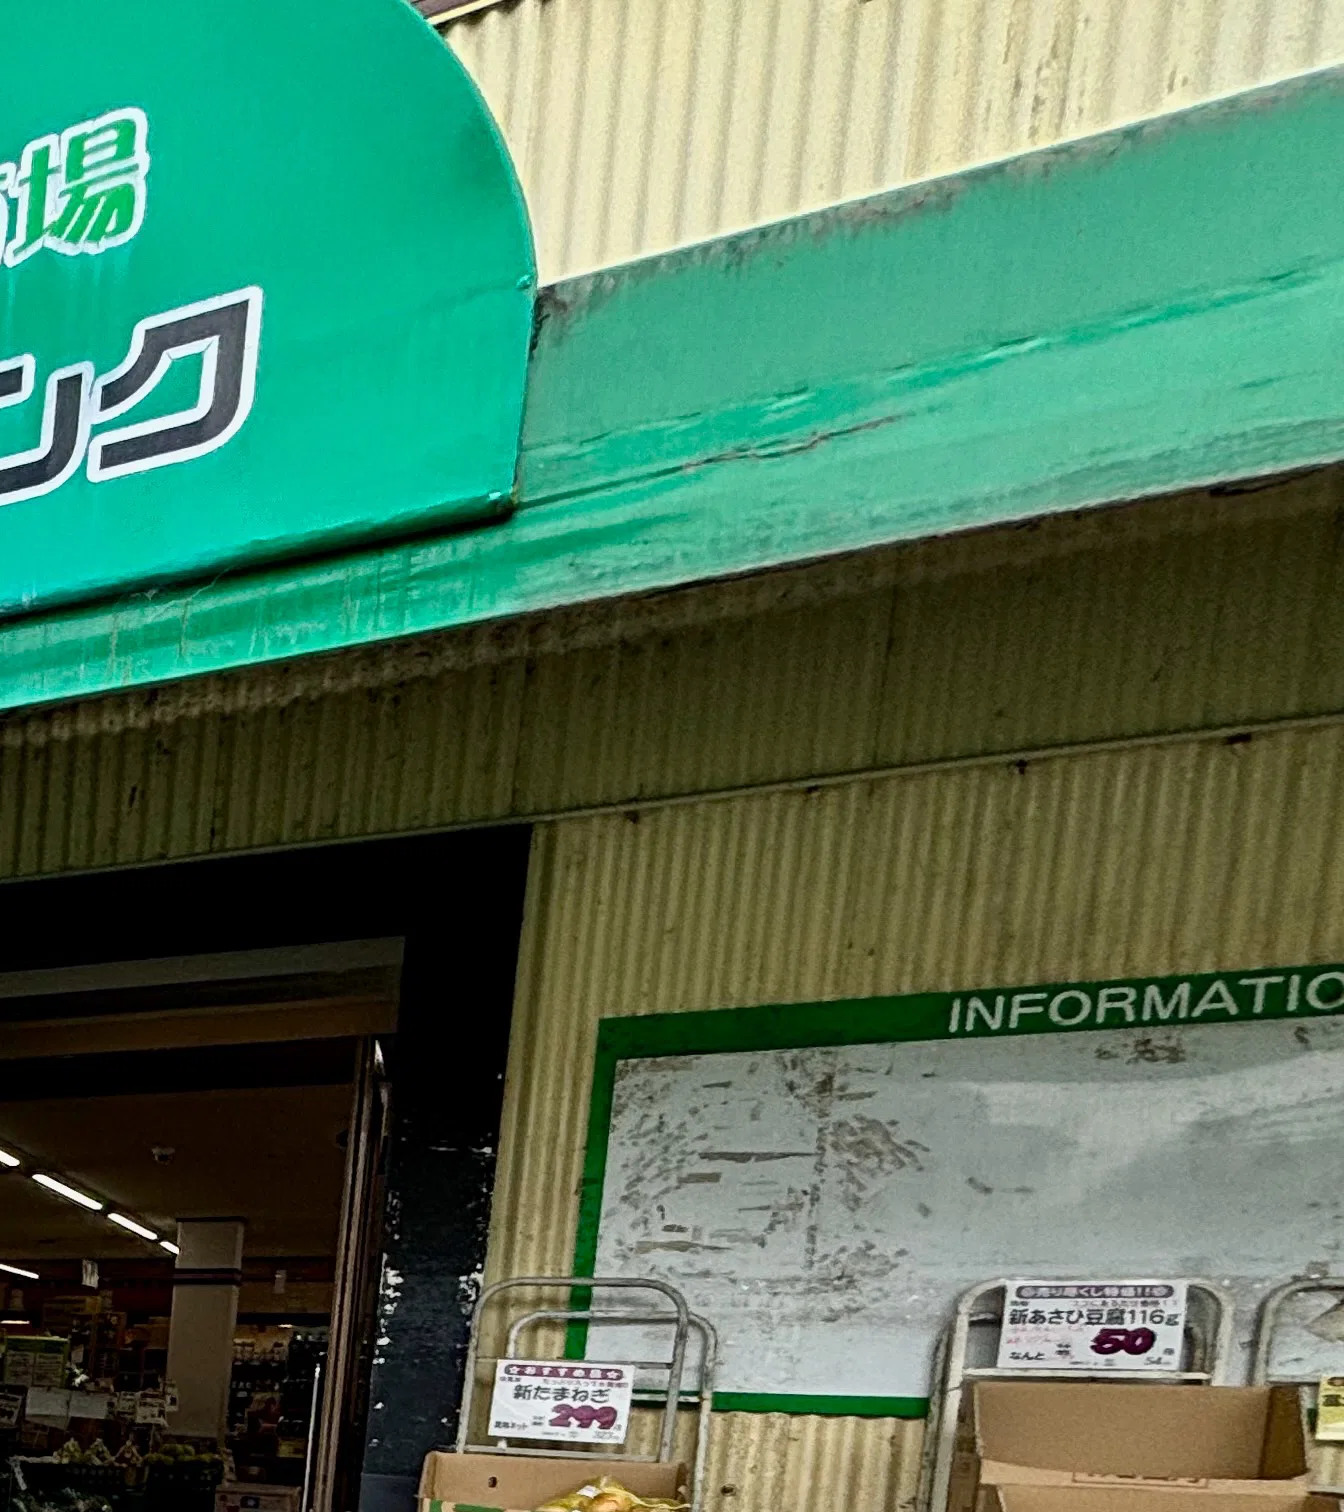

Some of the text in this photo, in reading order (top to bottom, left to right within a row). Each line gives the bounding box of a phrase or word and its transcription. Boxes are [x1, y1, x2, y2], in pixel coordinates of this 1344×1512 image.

[1009, 1307, 1180, 1326] 新あさひ豆腐116g
[1089, 1326, 1157, 1355] 50
[513, 1384, 611, 1403] 新たまねぎ
[548, 1403, 618, 1431] 299
